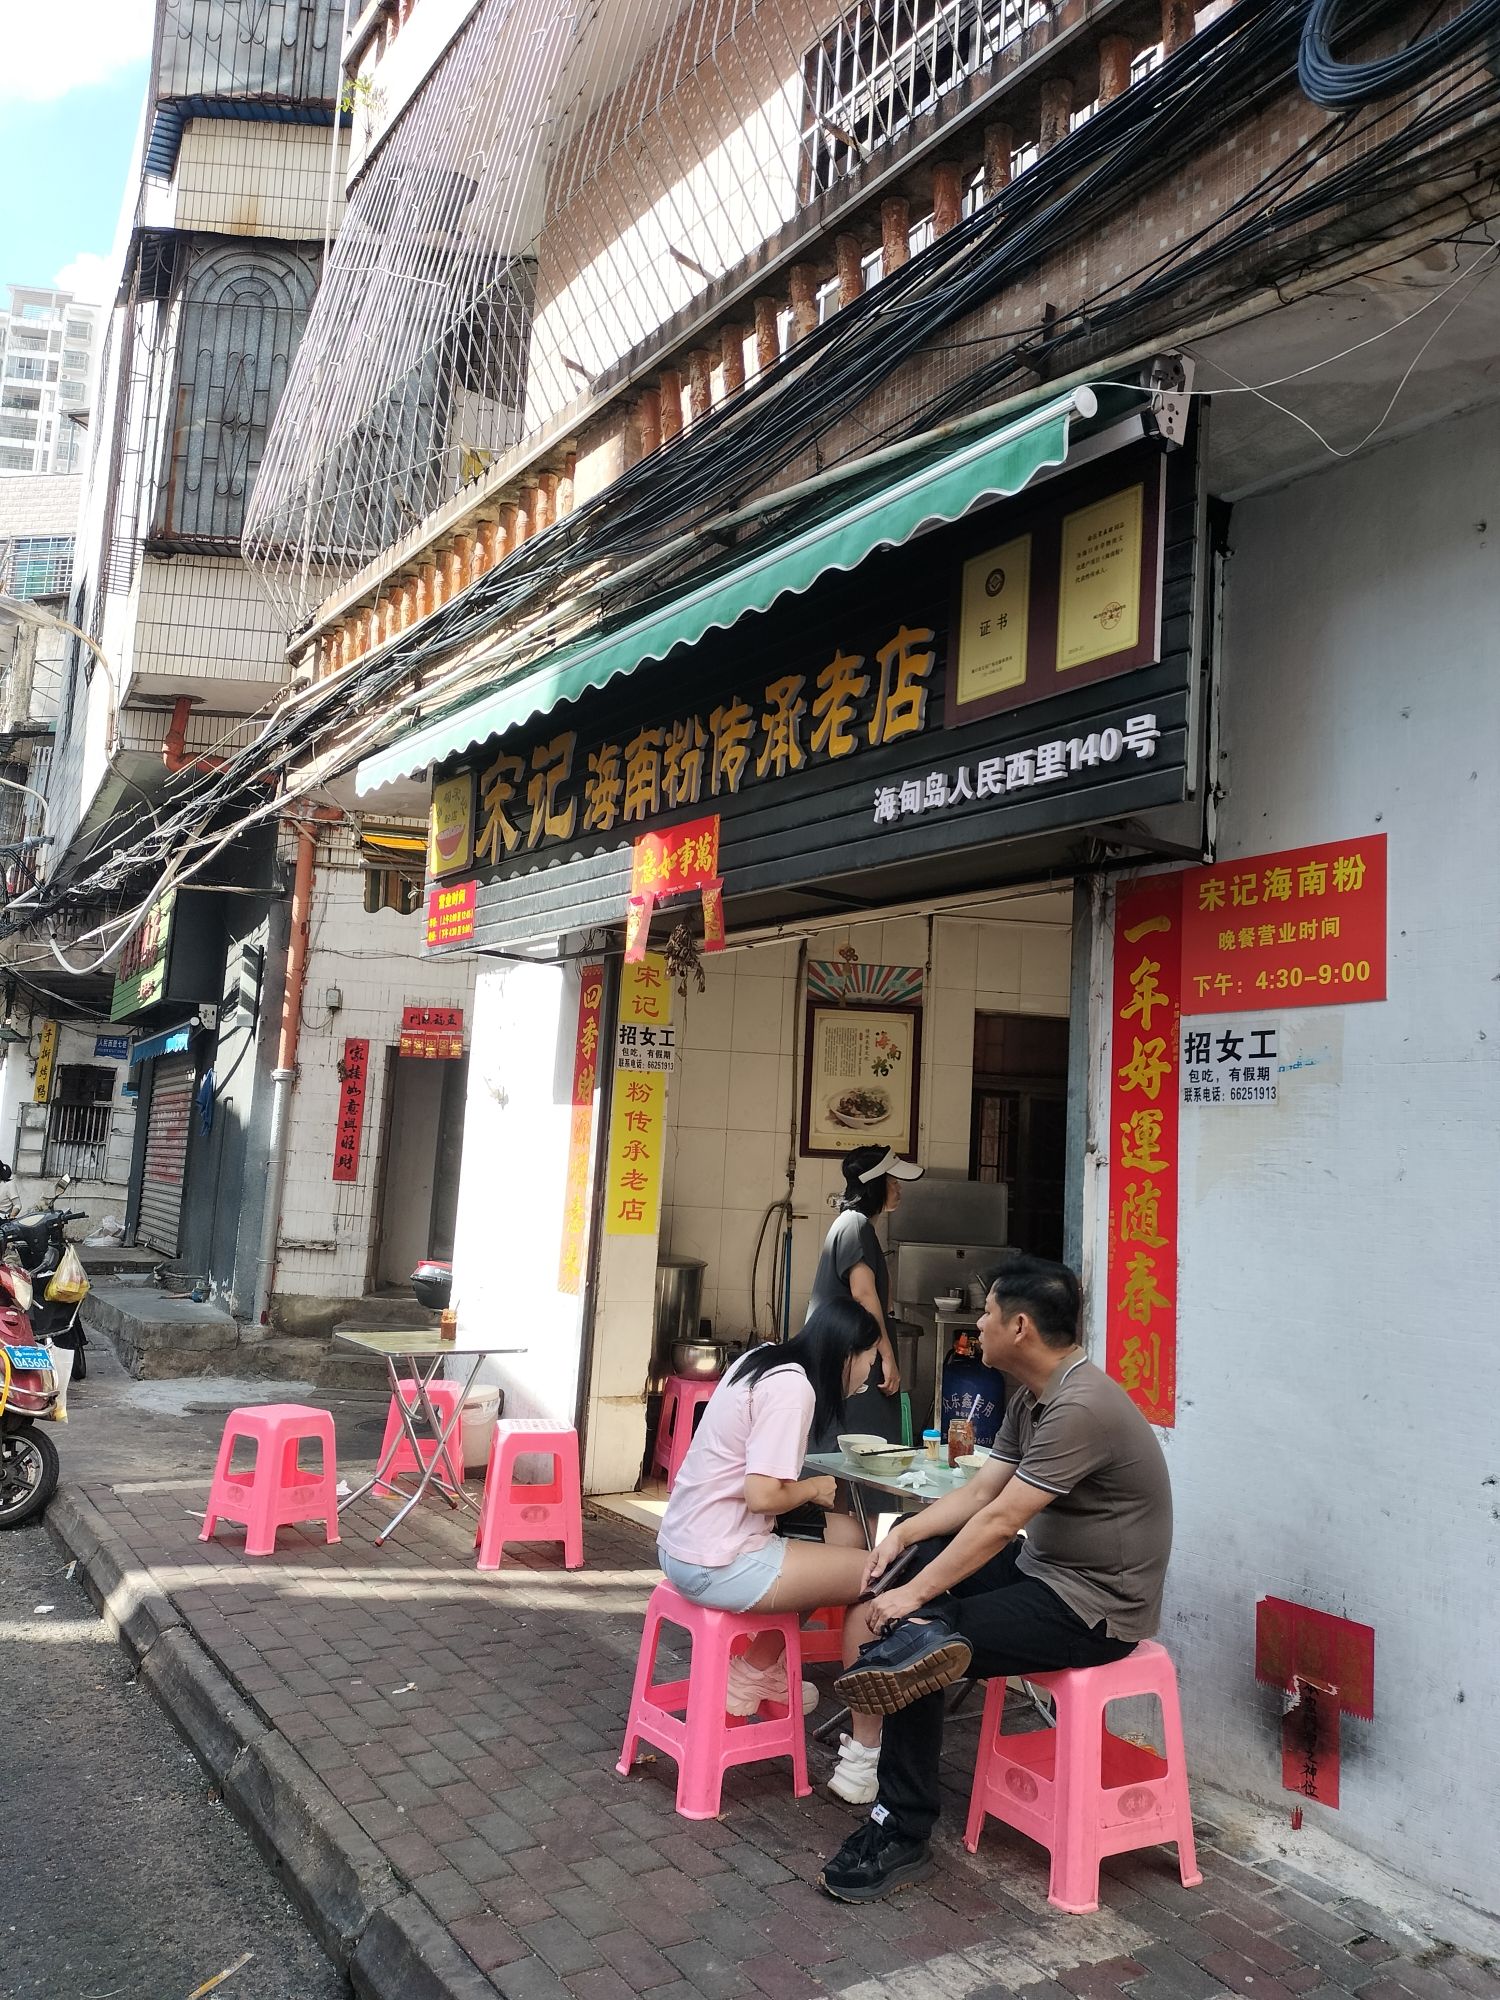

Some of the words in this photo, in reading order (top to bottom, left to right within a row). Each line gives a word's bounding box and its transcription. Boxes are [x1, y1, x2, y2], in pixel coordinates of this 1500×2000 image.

[979, 612, 1009, 637] 证书
[873, 713, 1160, 823] 海甸岛人民西里140号
[1198, 853, 1367, 912] 宋记海南粉
[1218, 916, 1341, 951] 晚餐营业时间
[619, 1024, 675, 1047] 招女工
[1184, 1029, 1277, 1064] 招女工
